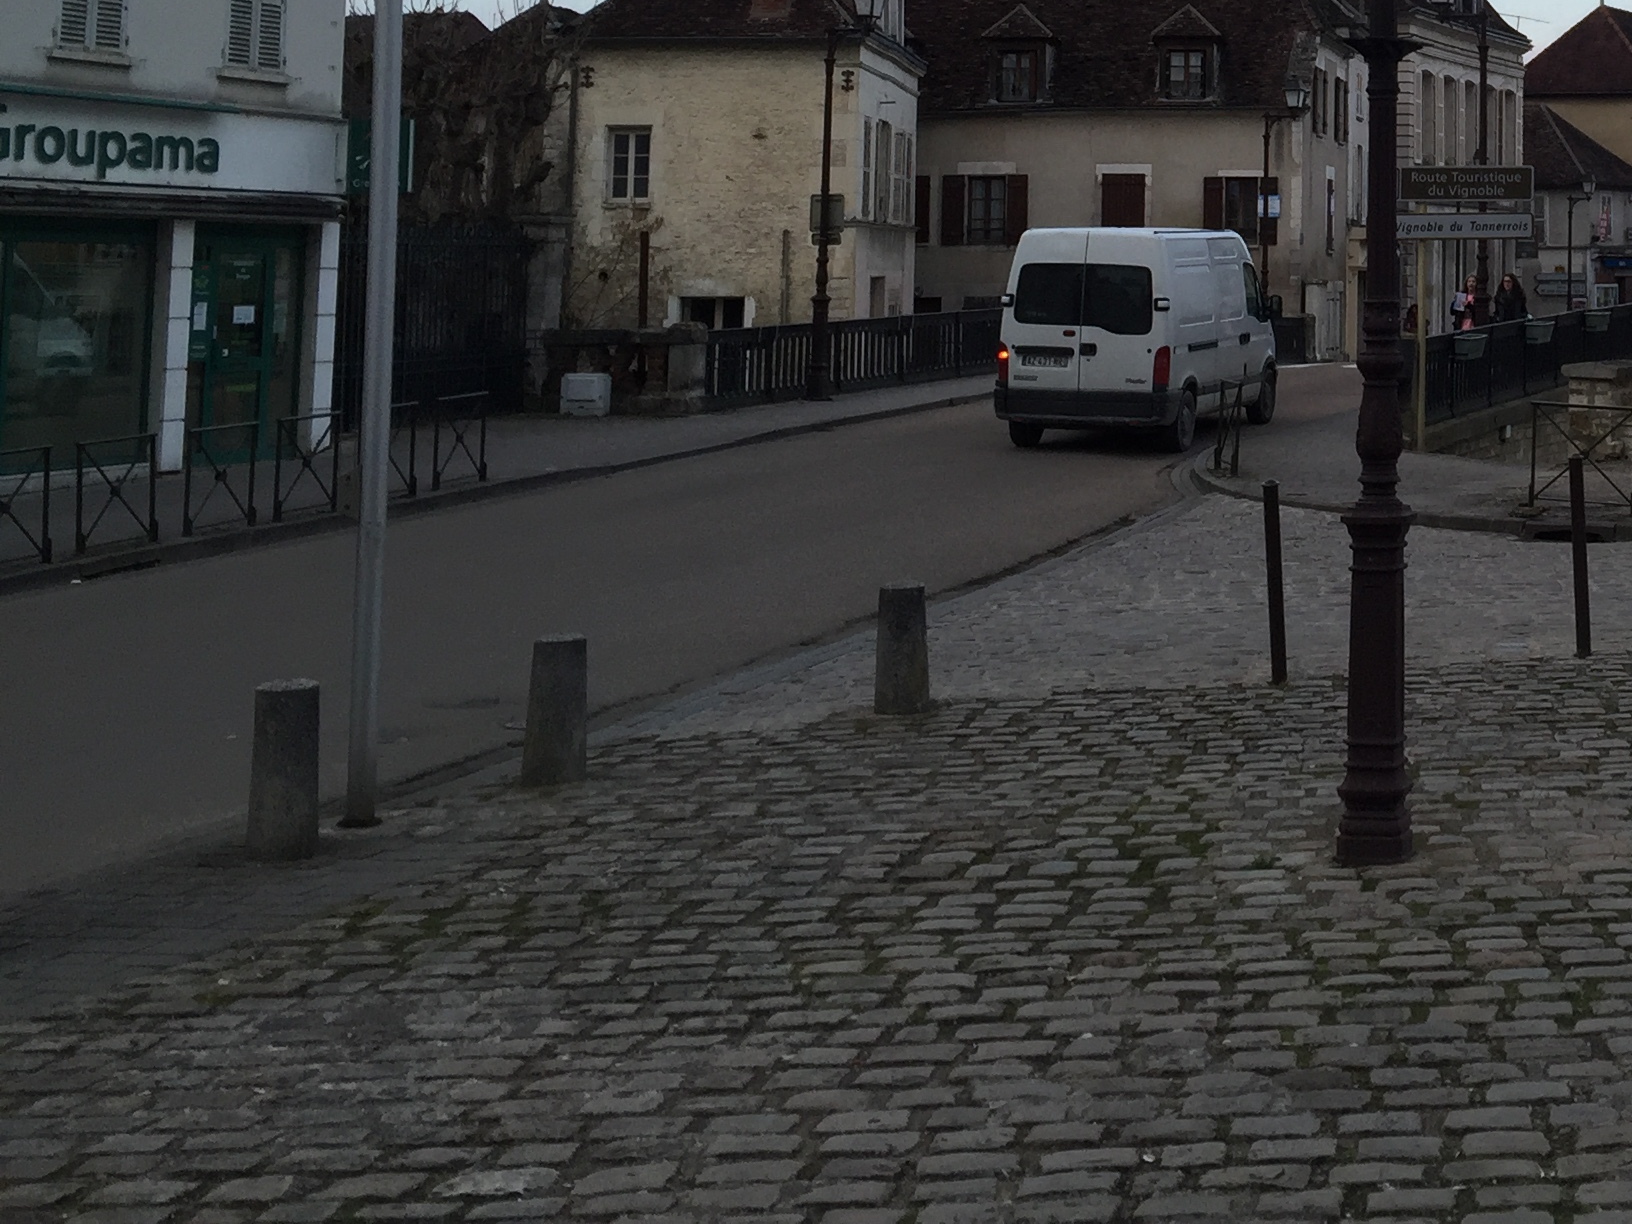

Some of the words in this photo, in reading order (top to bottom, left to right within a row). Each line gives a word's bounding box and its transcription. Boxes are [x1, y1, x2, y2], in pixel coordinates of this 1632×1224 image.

[0, 103, 219, 179] roupama
[1411, 171, 1448, 183] Route
[1451, 171, 1522, 184] Touristique
[1428, 185, 1444, 196] du
[1448, 185, 1505, 198] Vignoble
[1450, 222, 1463, 232] du
[1470, 221, 1529, 232] Tonnerrois
